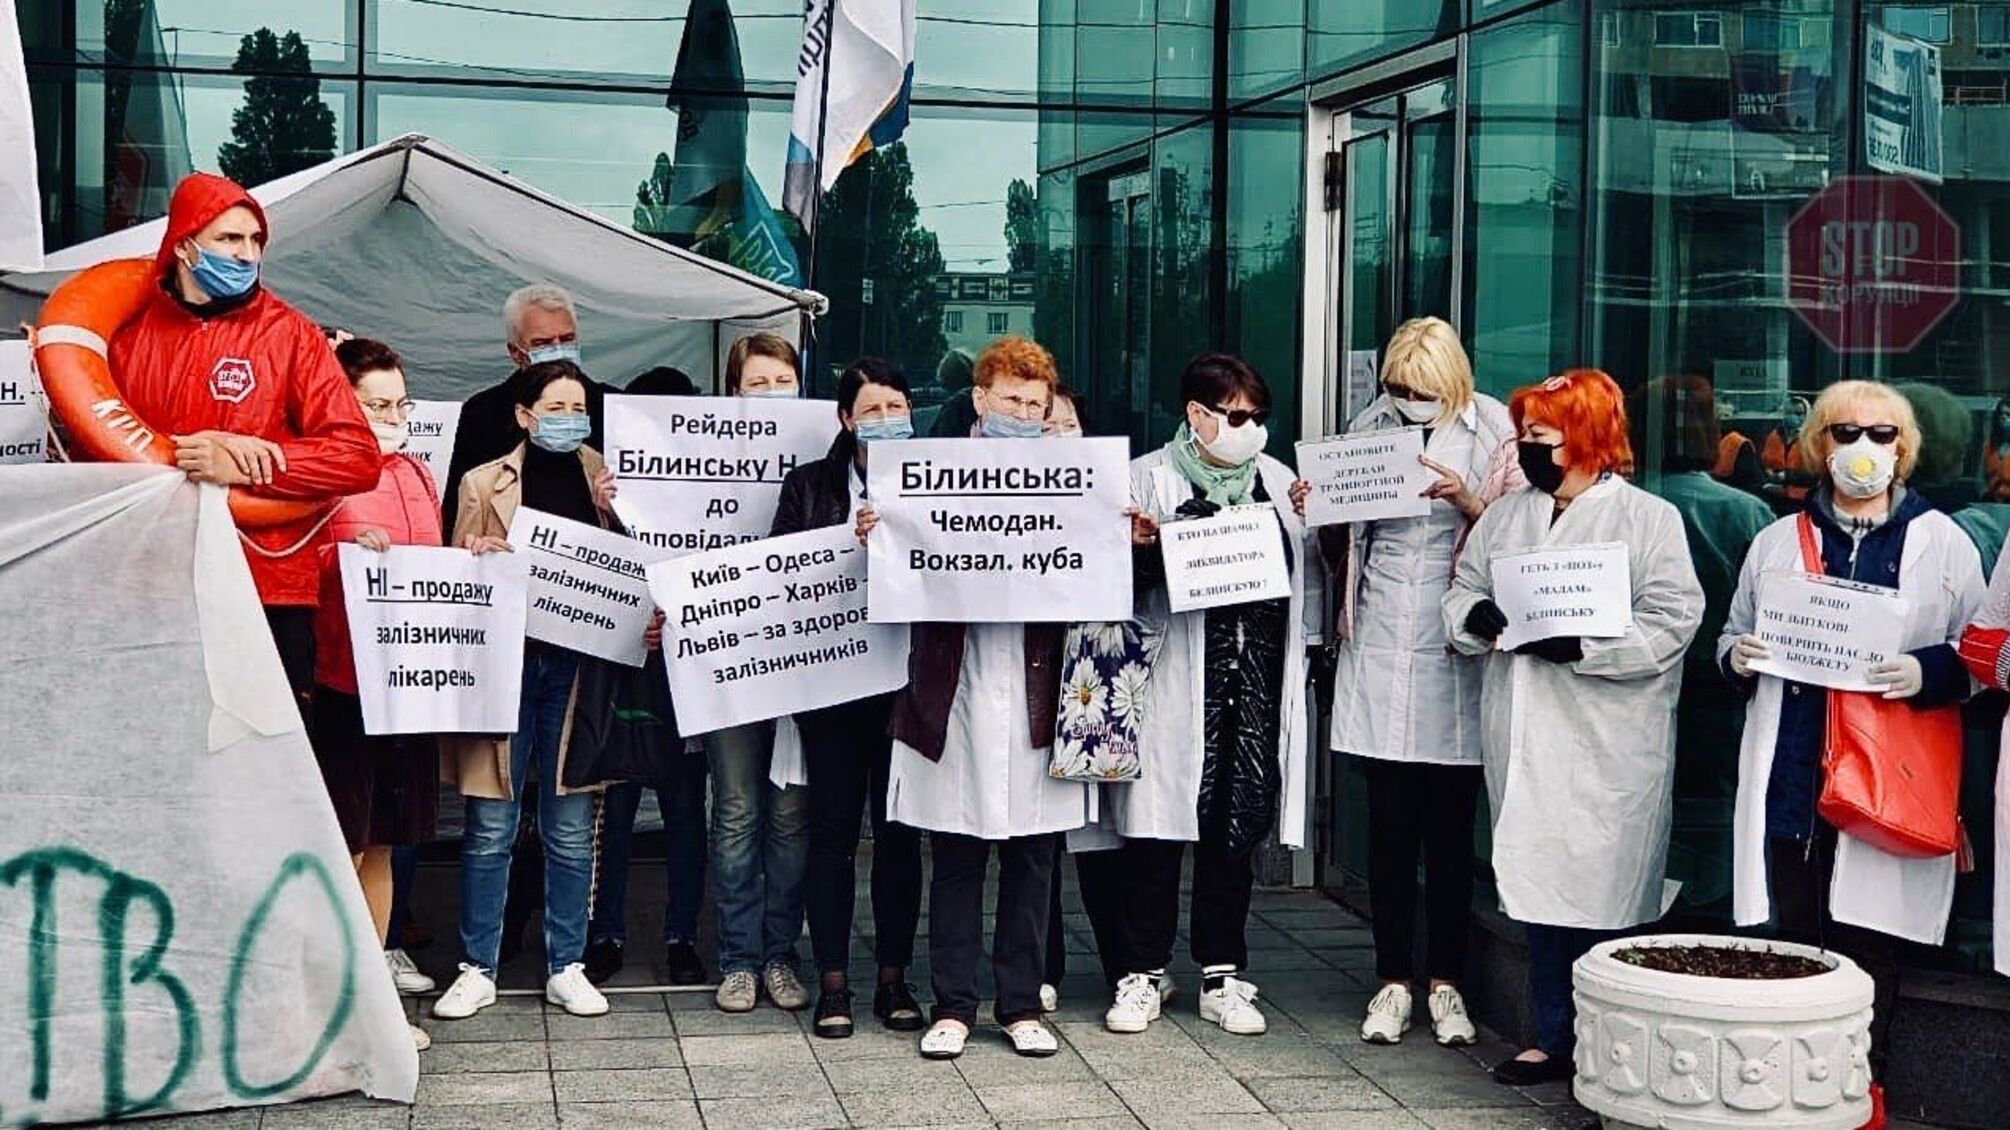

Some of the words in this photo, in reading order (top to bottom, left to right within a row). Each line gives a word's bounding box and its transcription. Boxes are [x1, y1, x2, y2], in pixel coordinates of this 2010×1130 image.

[671, 414, 777, 439] Рейдера
[619, 450, 768, 482] Білинську
[1319, 444, 1396, 461] ОСТАНОВИТЕ
[902, 461, 1093, 490] Білинська:
[706, 499, 739, 518] до
[931, 510, 1063, 536] Чемодан.
[530, 525, 558, 548] НІ
[691, 564, 741, 588] Київ
[765, 549, 836, 573] Одеса
[910, 549, 1013, 571] Вокзал.
[1022, 546, 1084, 575] куба
[366, 567, 387, 596] НІ
[412, 580, 493, 605] продажу
[529, 565, 641, 608] залізничних
[533, 596, 616, 630] лікарень
[681, 594, 761, 627] Дніпро
[785, 575, 858, 603] Харків
[1809, 595, 1850, 611] ЯКЩО
[376, 622, 487, 645] залізничних
[677, 630, 740, 659] Львів
[763, 624, 786, 640] за
[713, 638, 869, 684] залізничників
[1786, 651, 1852, 672] БЮДЖЕТУ
[388, 664, 475, 691] лікарень
